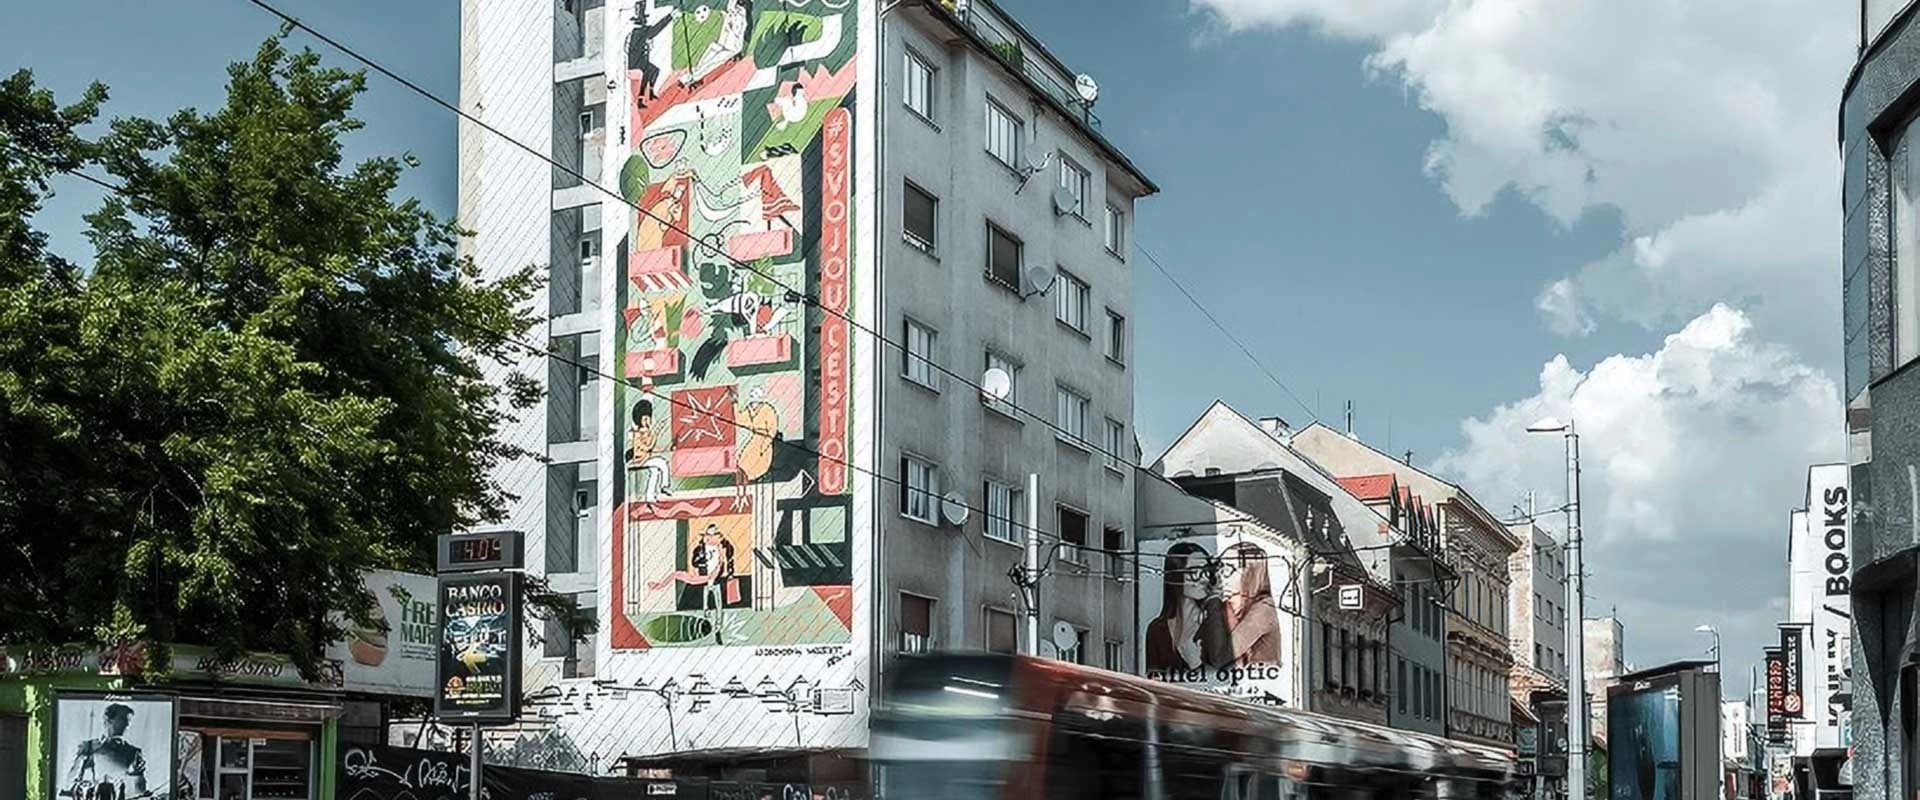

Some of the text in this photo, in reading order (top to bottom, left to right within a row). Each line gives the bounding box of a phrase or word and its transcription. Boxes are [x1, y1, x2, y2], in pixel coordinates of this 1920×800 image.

[823, 323, 844, 490] CESTOU
[1824, 486, 1850, 597] BOOKS
[447, 584, 502, 600] BANCO
[445, 600, 505, 617] CASINO
[1147, 662, 1280, 687] eiffel optic
